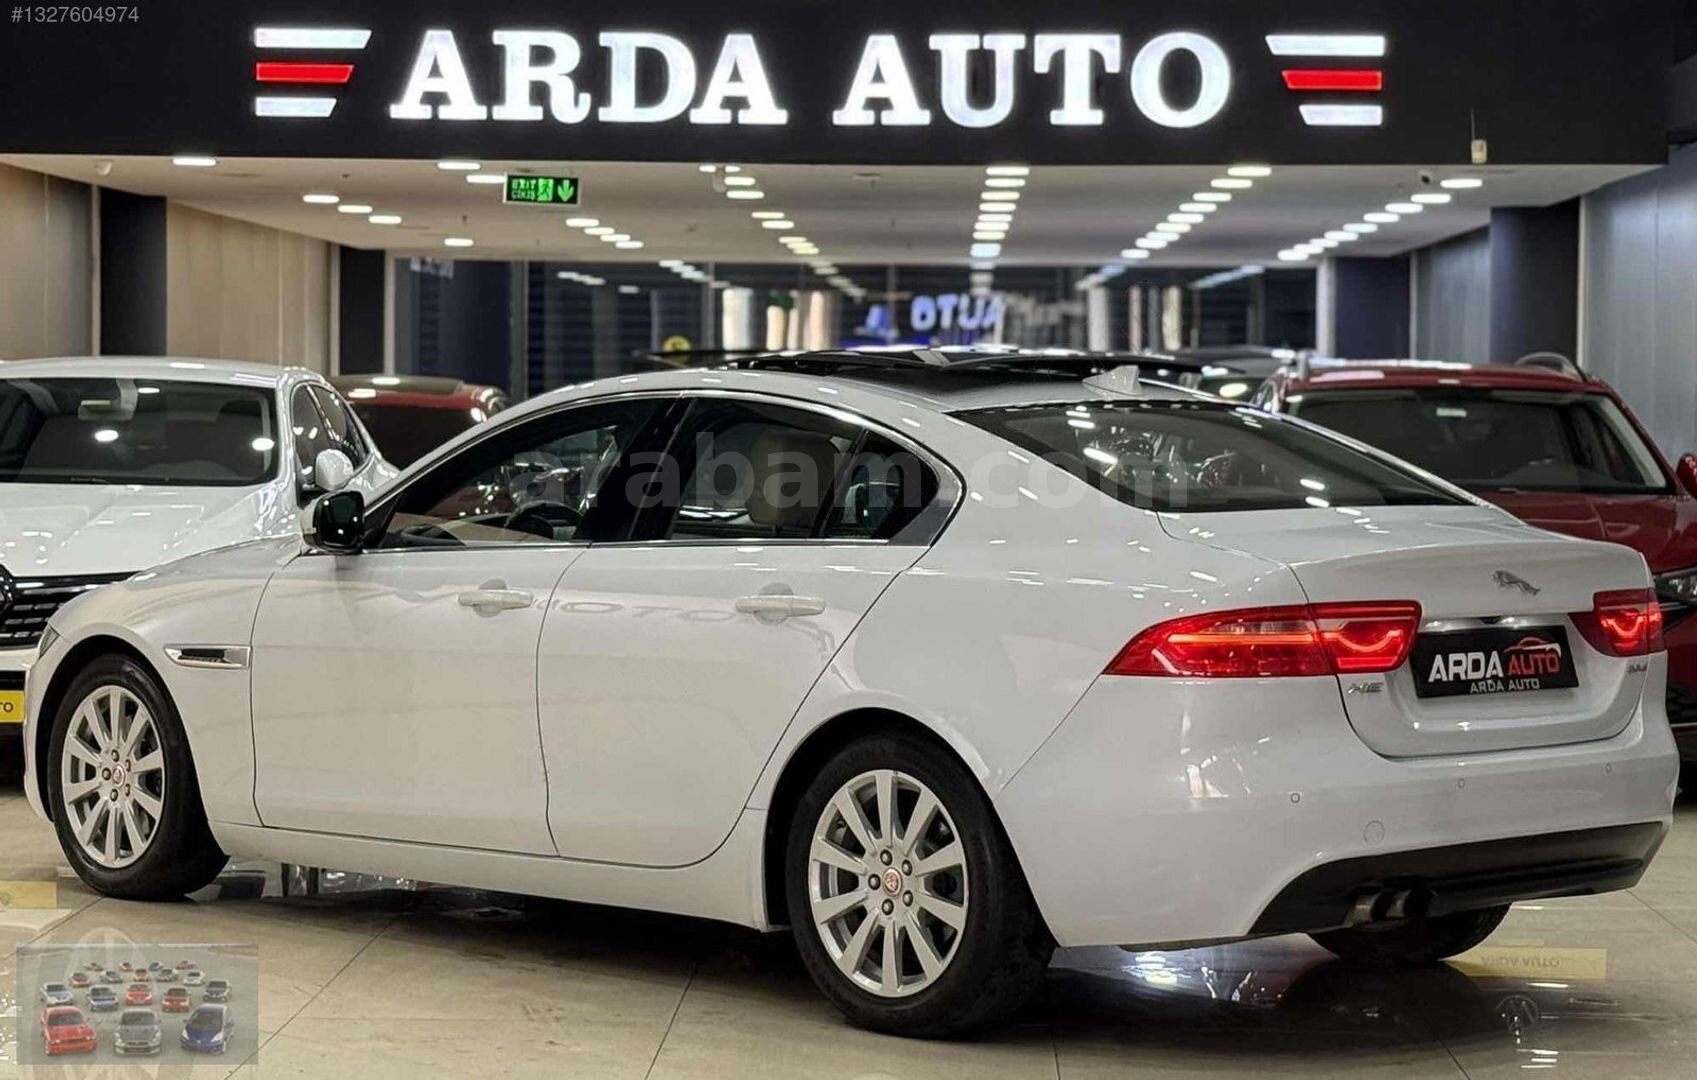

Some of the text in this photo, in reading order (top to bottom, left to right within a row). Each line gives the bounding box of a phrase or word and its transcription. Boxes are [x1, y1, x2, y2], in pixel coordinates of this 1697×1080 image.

[389, 29, 1232, 128] ARDA AUTO
[511, 179, 536, 190] EXIT
[1428, 650, 1561, 683] ARDA AUTO
[1470, 678, 1540, 694] ARDA AUTO
